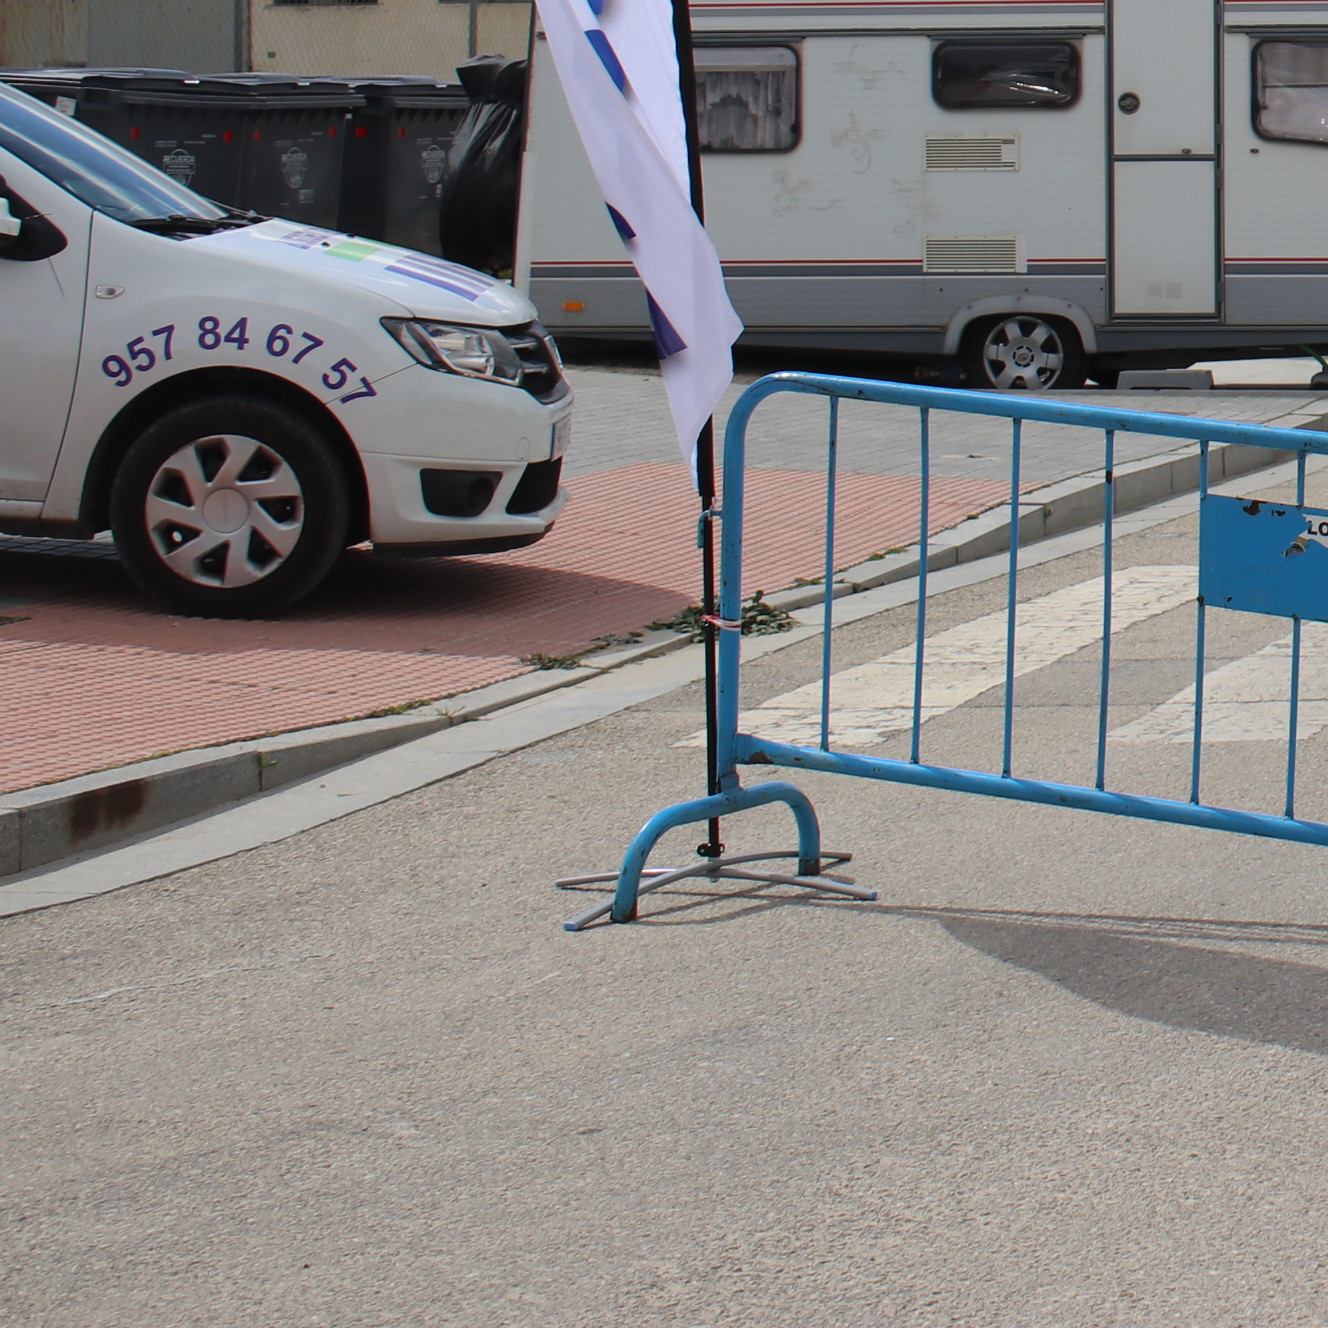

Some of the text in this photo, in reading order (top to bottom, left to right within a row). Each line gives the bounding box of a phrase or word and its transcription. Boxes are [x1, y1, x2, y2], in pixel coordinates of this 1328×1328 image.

[102, 315, 377, 404] 957 84 67 57
